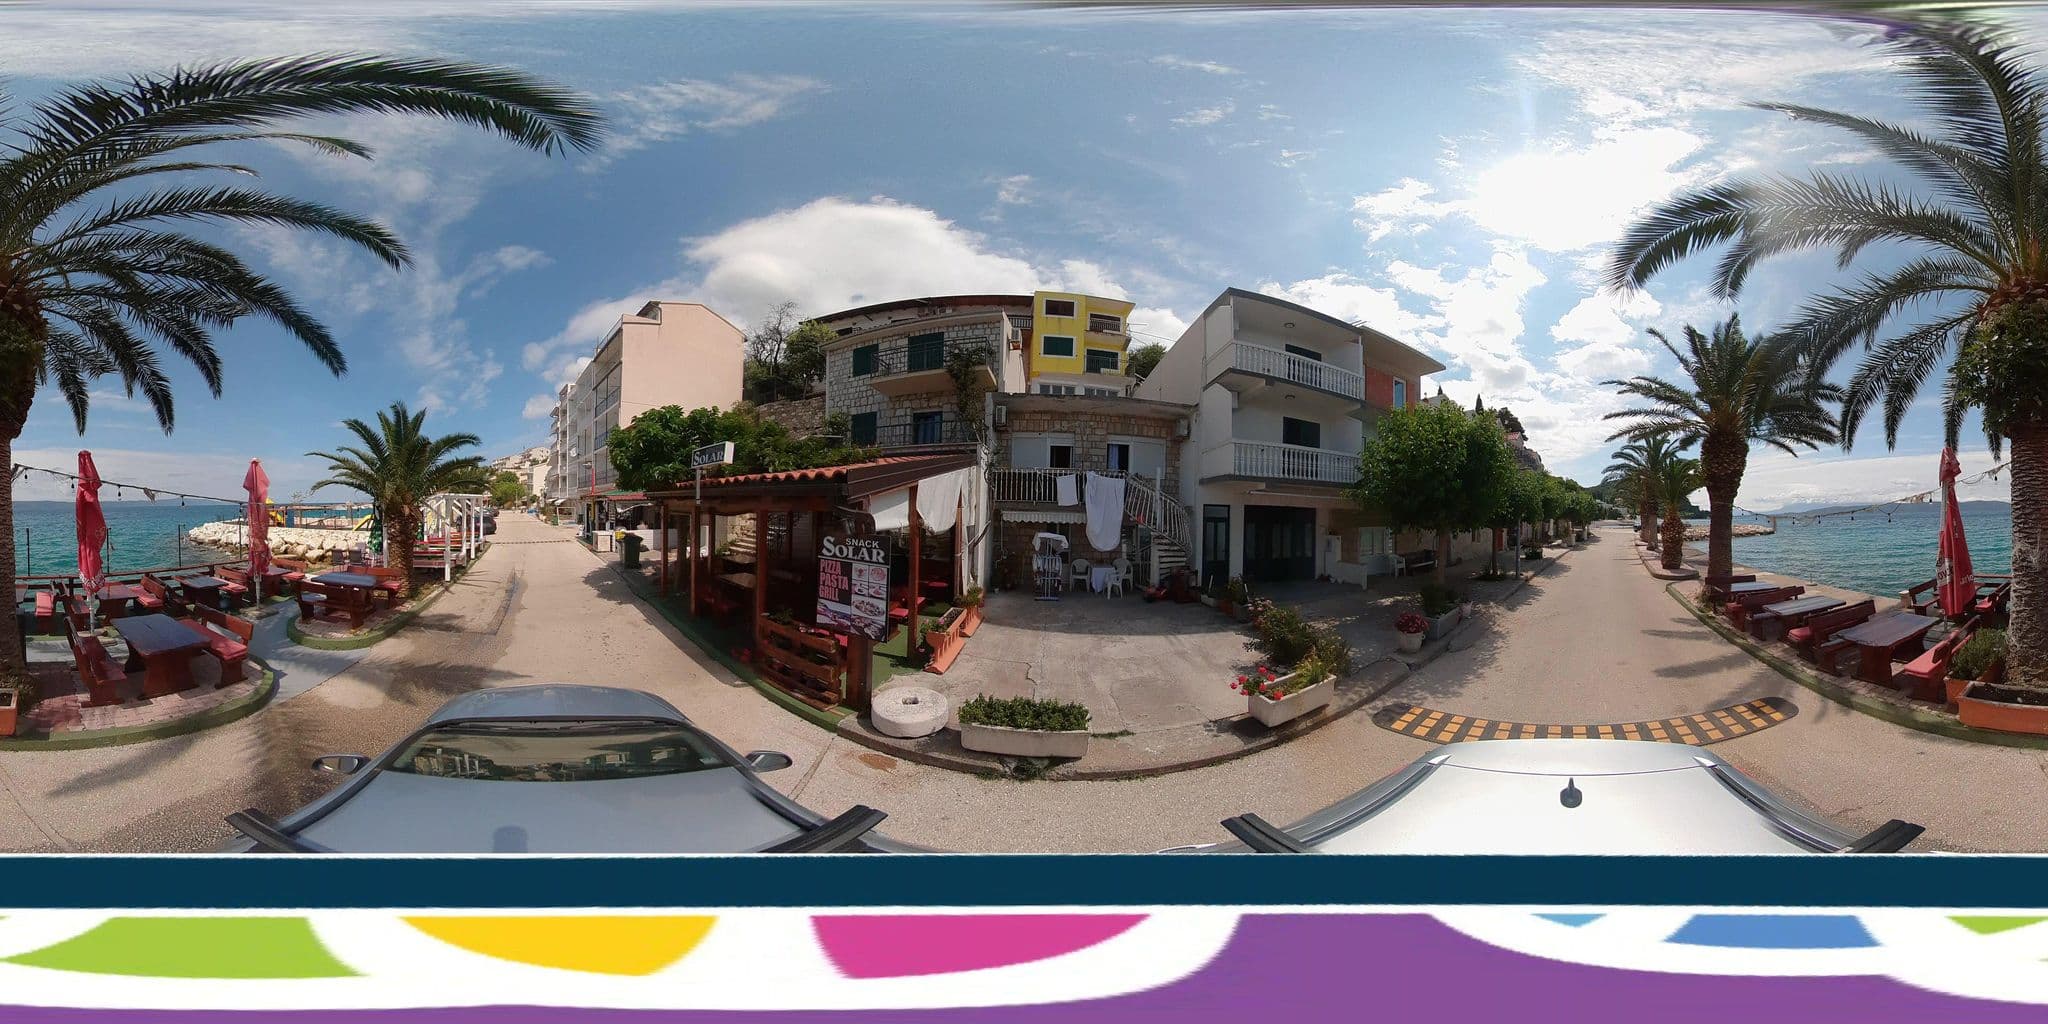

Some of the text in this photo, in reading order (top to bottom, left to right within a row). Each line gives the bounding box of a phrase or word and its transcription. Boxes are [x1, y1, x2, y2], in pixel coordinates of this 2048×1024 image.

[694, 451, 723, 466] SOLAR
[822, 536, 885, 563] SOLAR
[846, 538, 880, 549] SNACK
[820, 559, 841, 575] PIZZA
[820, 572, 849, 591] PASTA
[819, 585, 839, 600] GRILL
